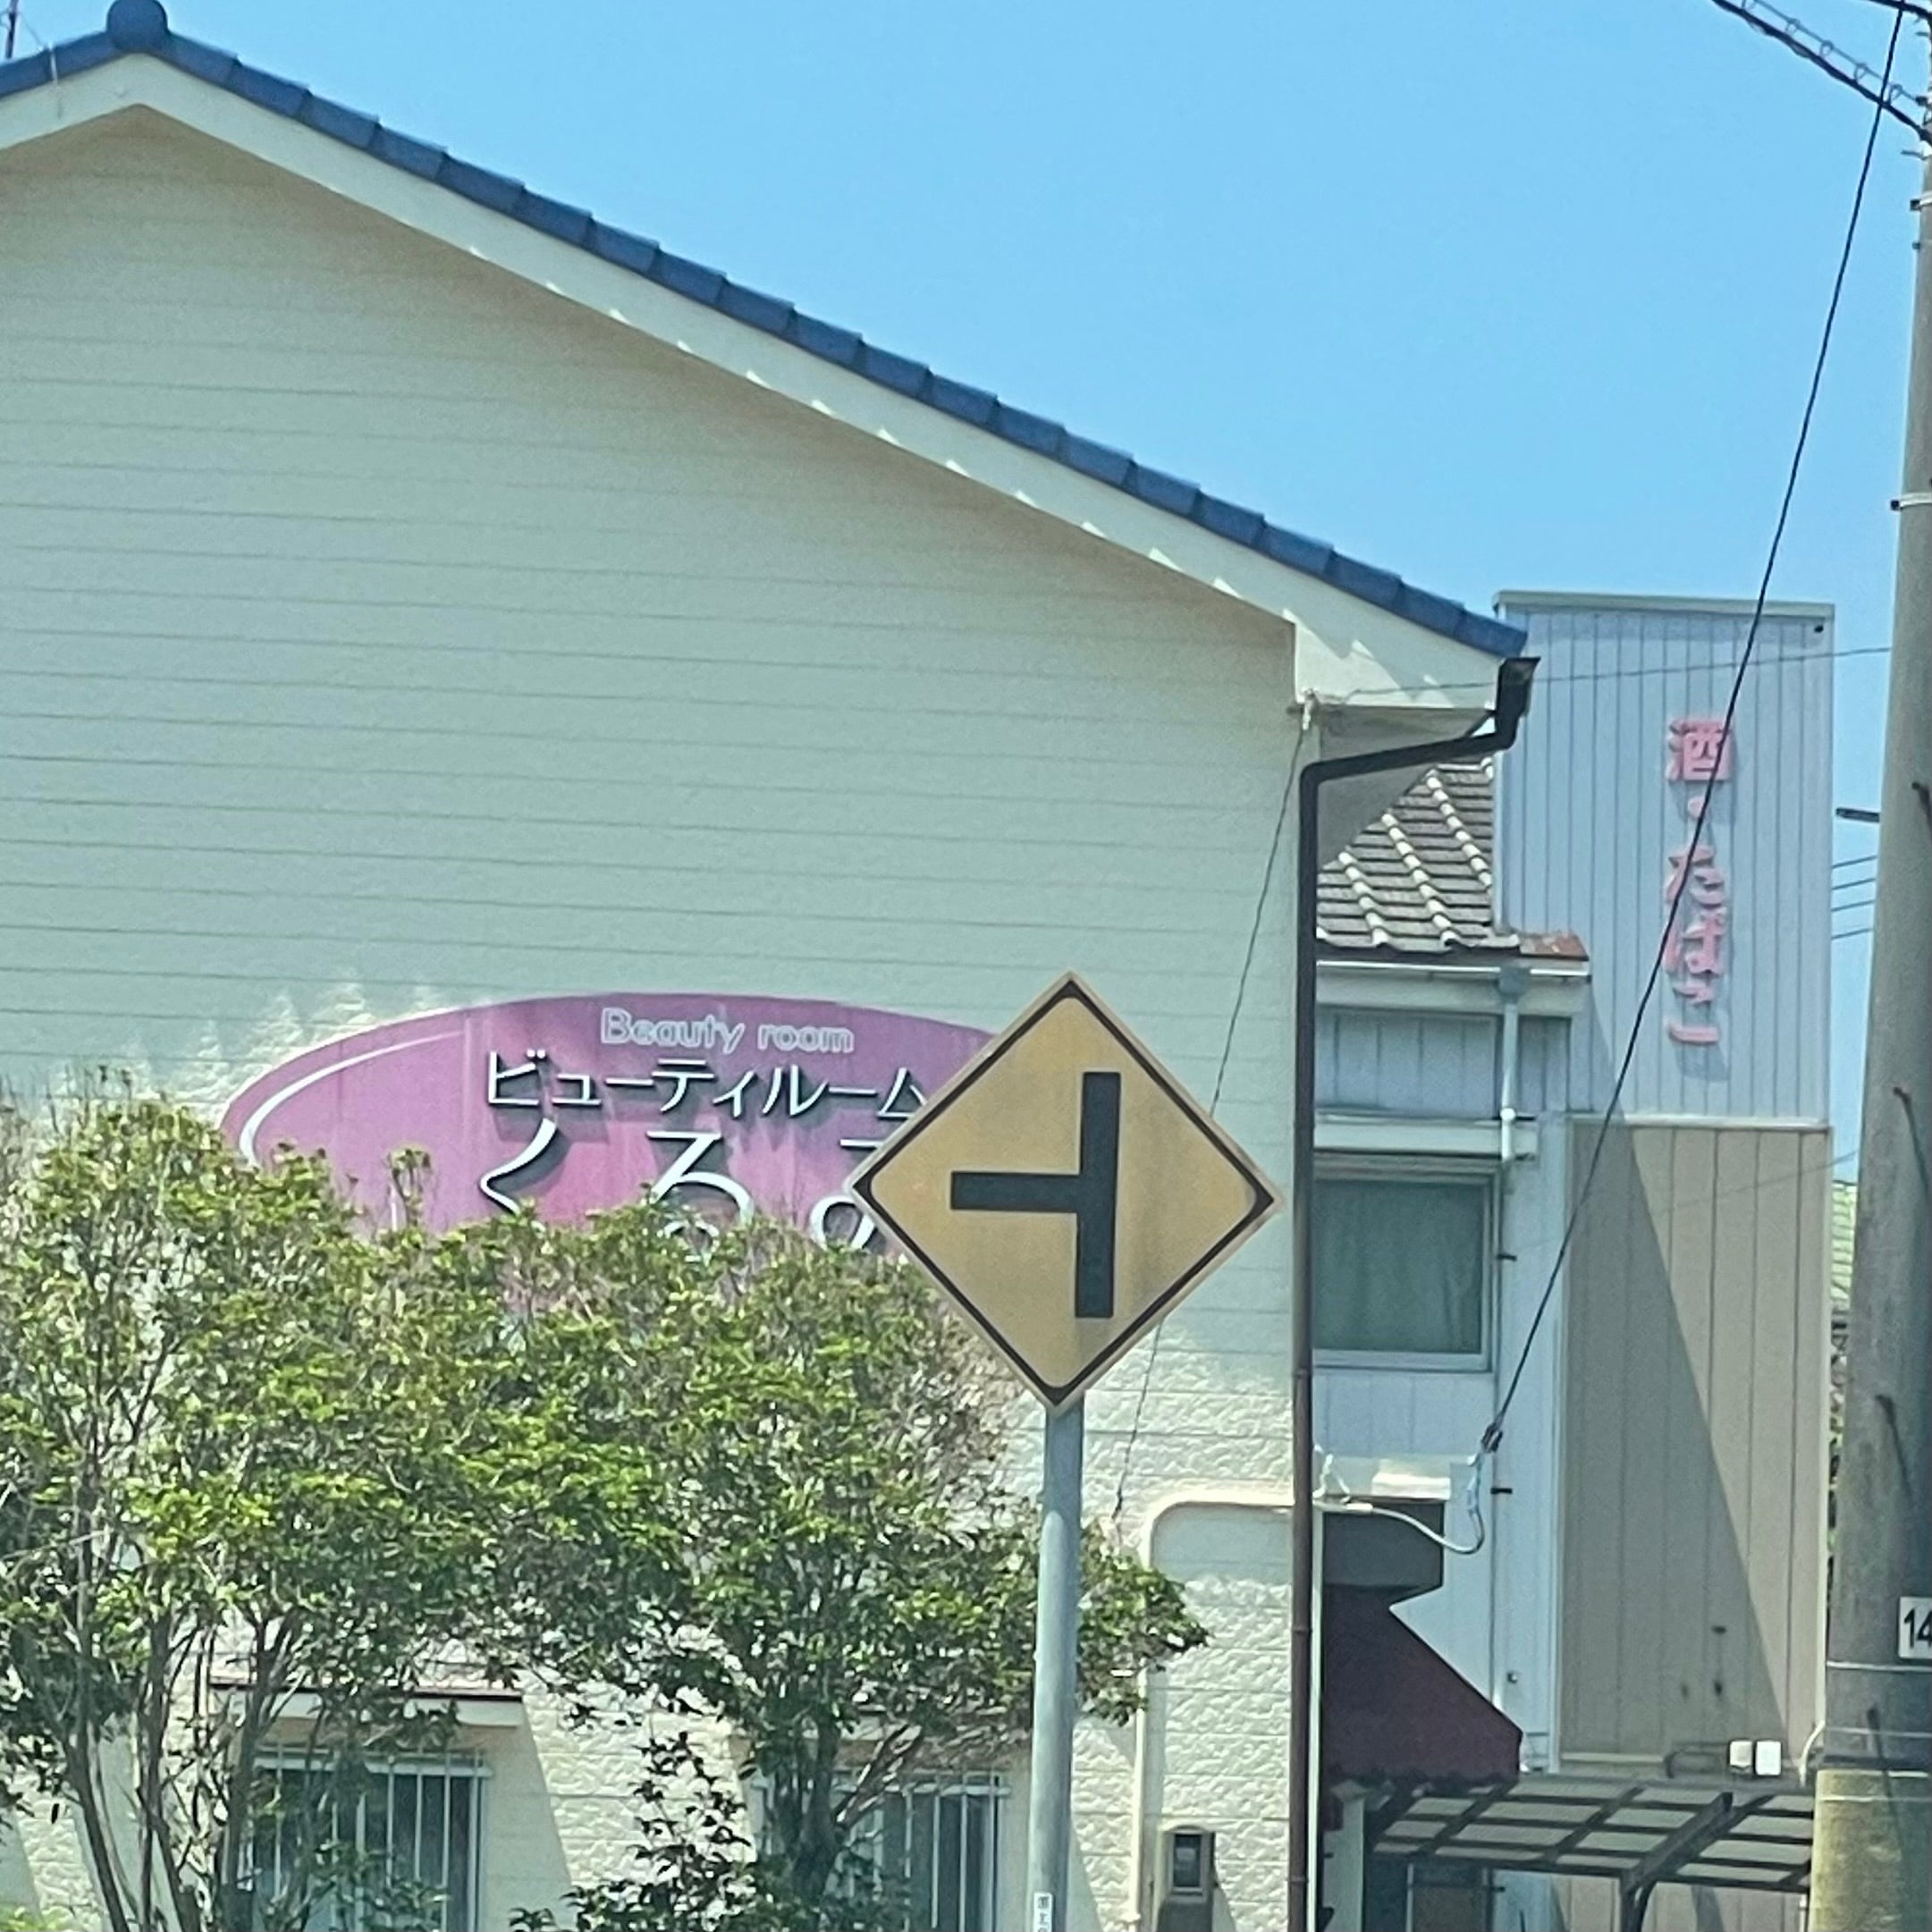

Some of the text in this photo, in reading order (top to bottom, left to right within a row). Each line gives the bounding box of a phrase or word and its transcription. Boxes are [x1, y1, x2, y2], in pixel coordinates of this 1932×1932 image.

[601, 1008, 855, 1054] Beauty room
[487, 1050, 927, 1119] ビューティルーム
